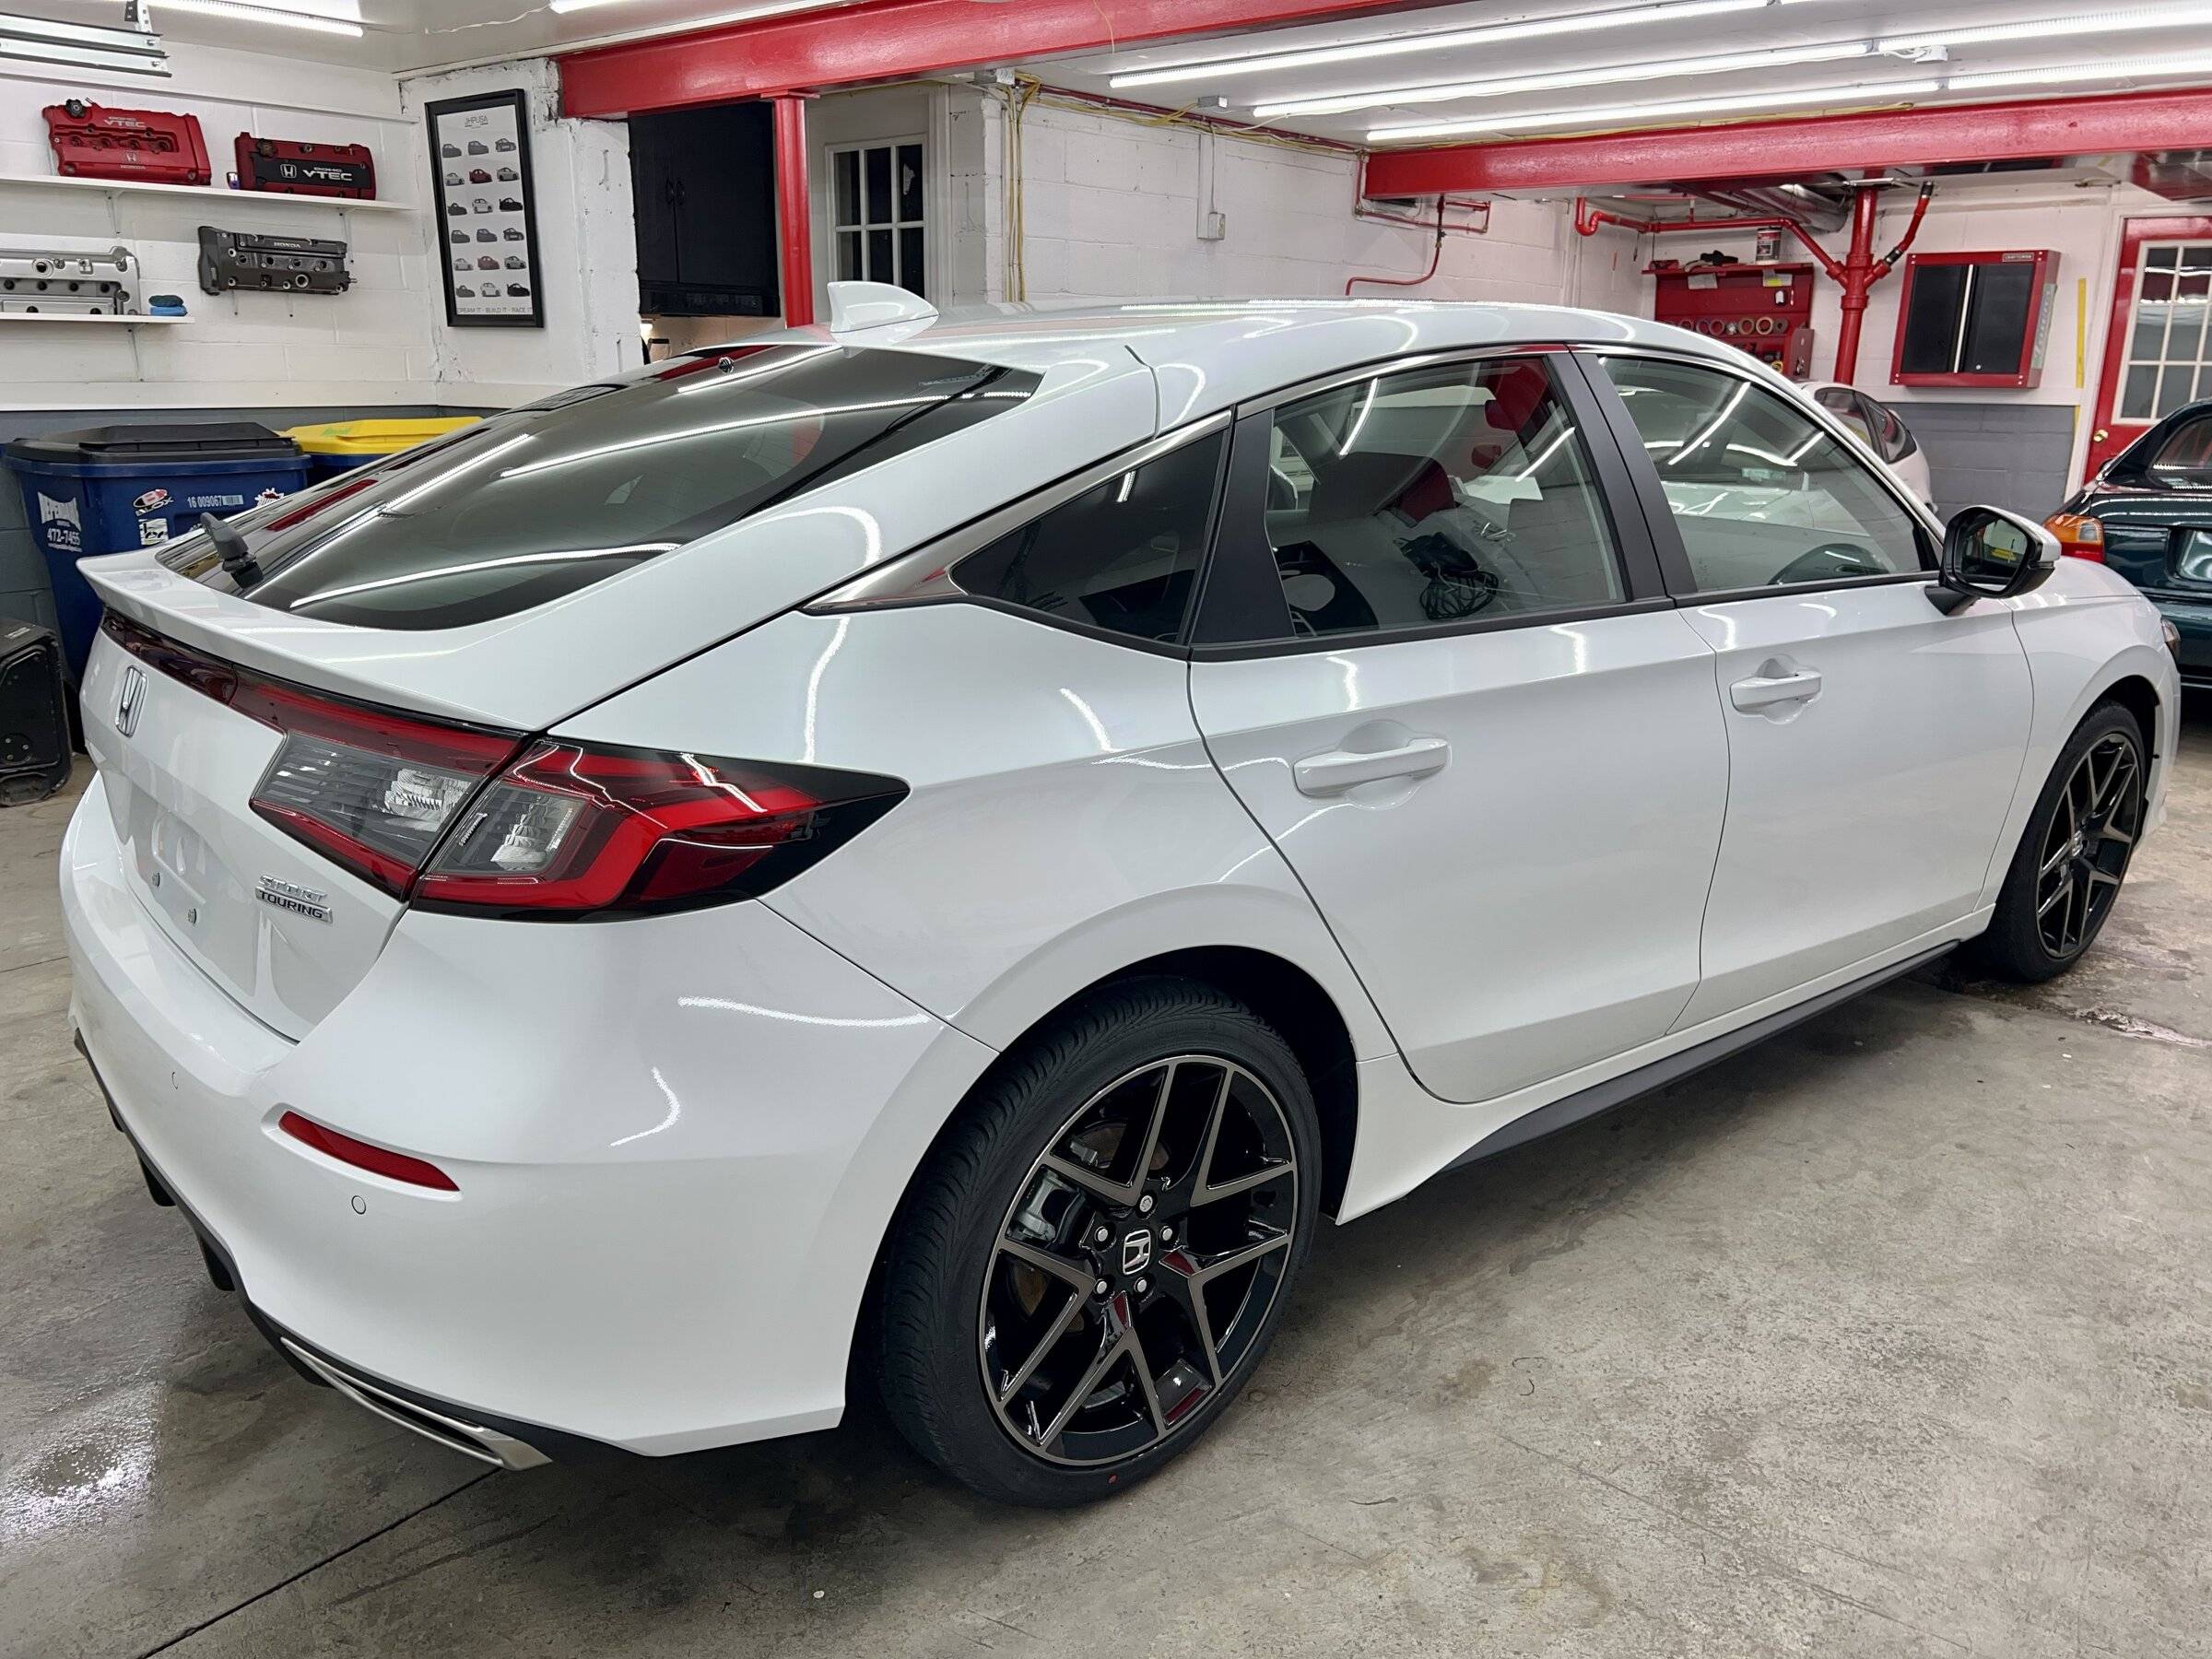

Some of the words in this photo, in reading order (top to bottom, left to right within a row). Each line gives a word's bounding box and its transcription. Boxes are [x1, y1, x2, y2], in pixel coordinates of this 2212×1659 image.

[103, 119, 147, 128] VTEC
[302, 170, 353, 182] VTEC
[187, 496, 197, 509] 16
[259, 889, 324, 920] TOURING
